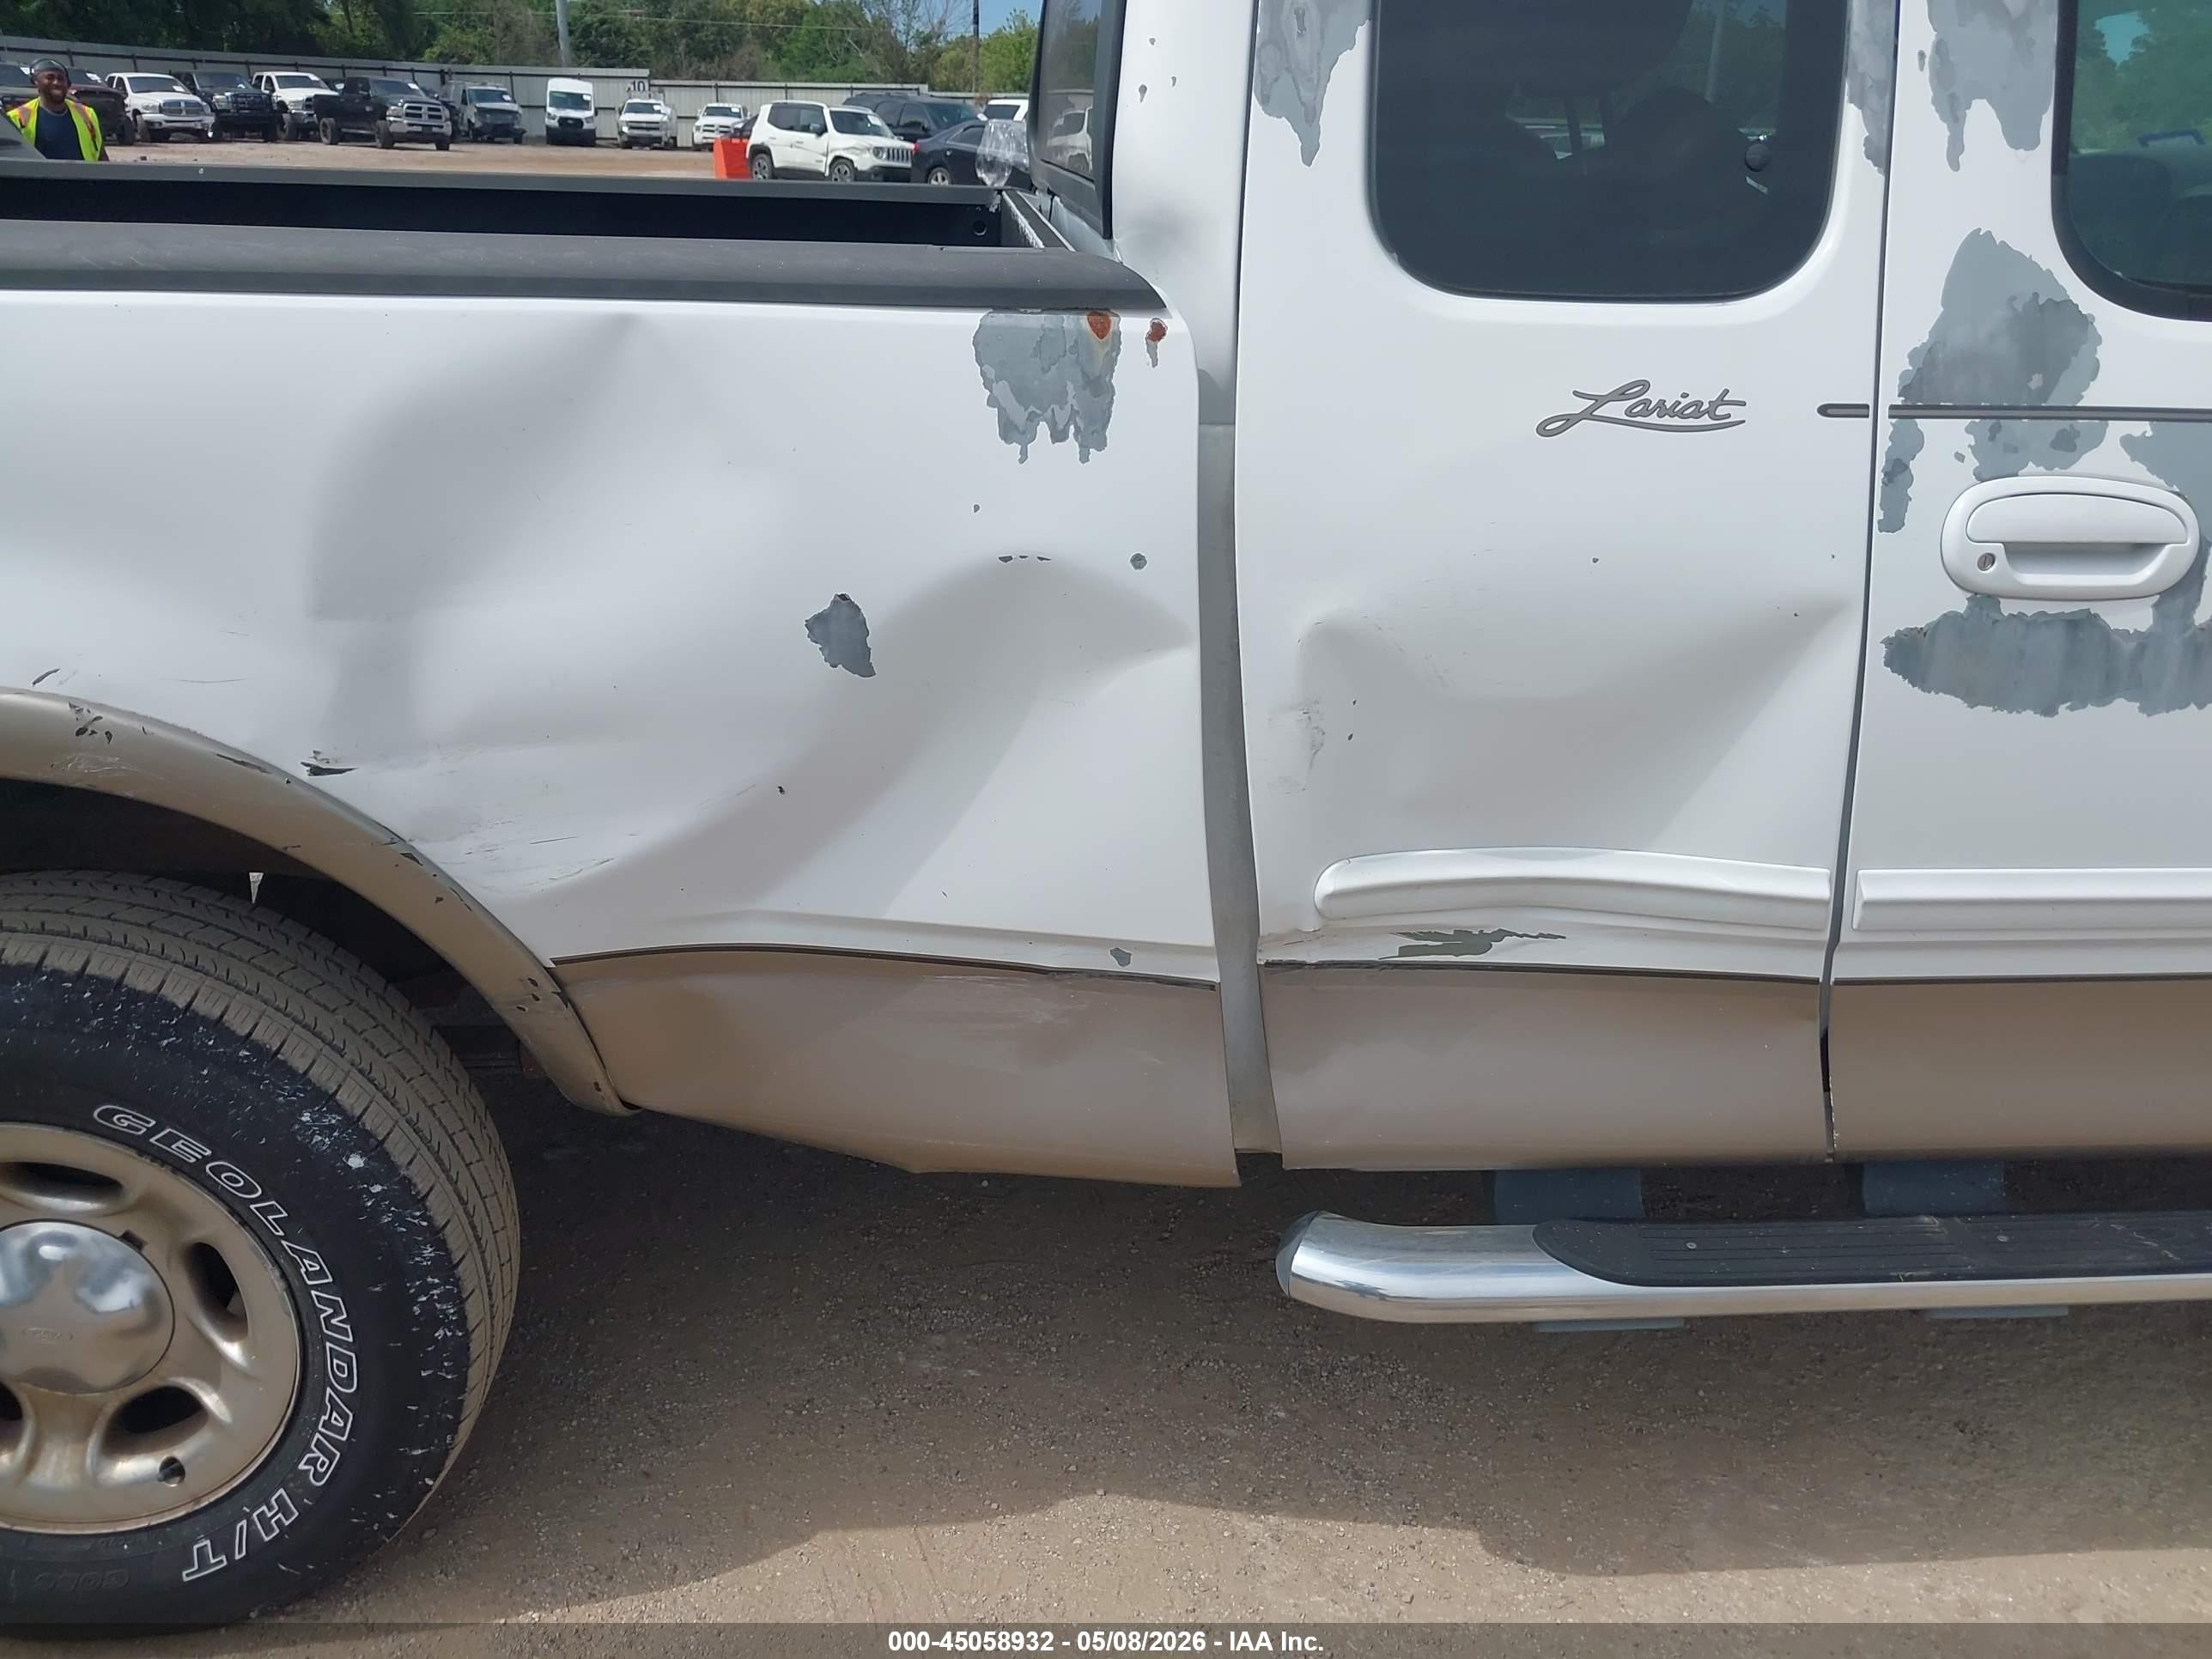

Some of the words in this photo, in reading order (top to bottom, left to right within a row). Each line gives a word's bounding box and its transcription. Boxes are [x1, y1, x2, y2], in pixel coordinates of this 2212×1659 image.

[1535, 379, 1747, 438] Lariat
[93, 1104, 357, 1486] GEOLANDAR
[182, 1488, 300, 1582] H/T
